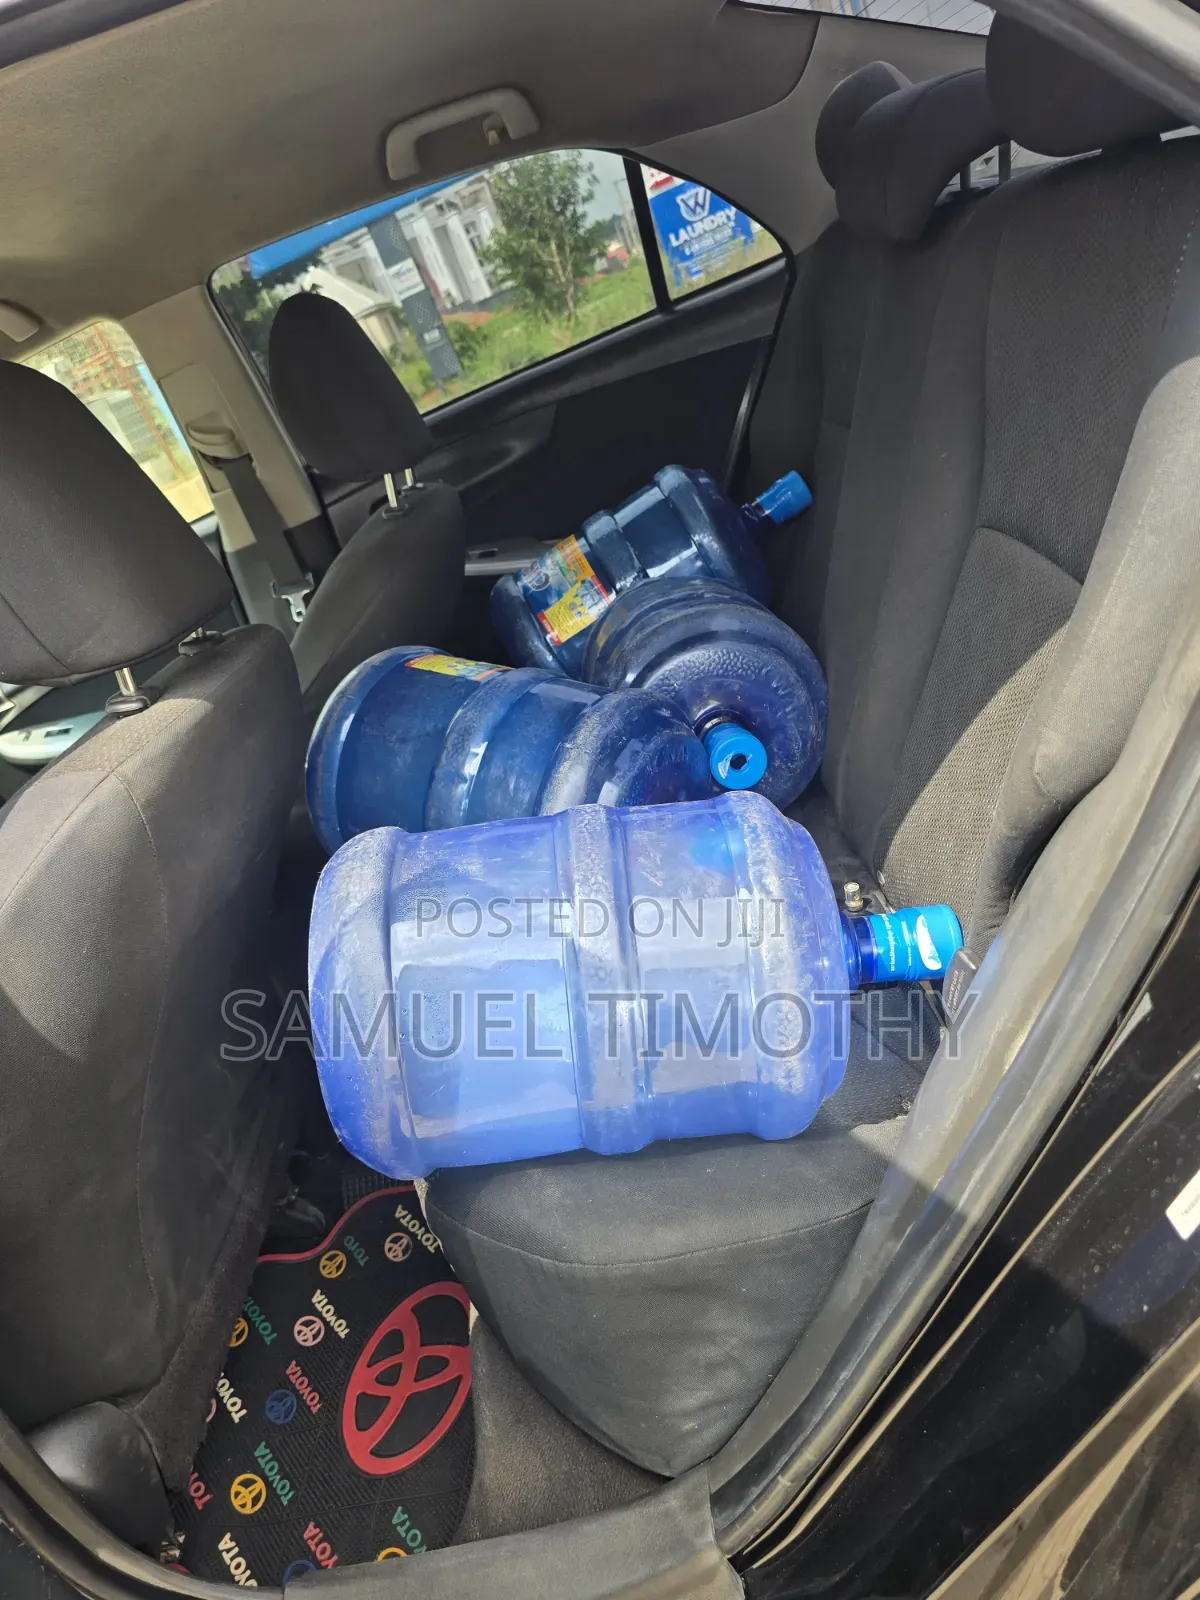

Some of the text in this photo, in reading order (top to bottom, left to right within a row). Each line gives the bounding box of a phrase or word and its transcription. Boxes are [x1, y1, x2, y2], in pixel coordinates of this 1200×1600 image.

[668, 206, 737, 247] LAUNDRY
[394, 1204, 440, 1253] TOYOTA
[311, 1289, 350, 1339] TOYOTA
[216, 1372, 248, 1424] TOYO
[285, 1360, 322, 1414] TOYOTA
[254, 1441, 295, 1506] TOYOTA
